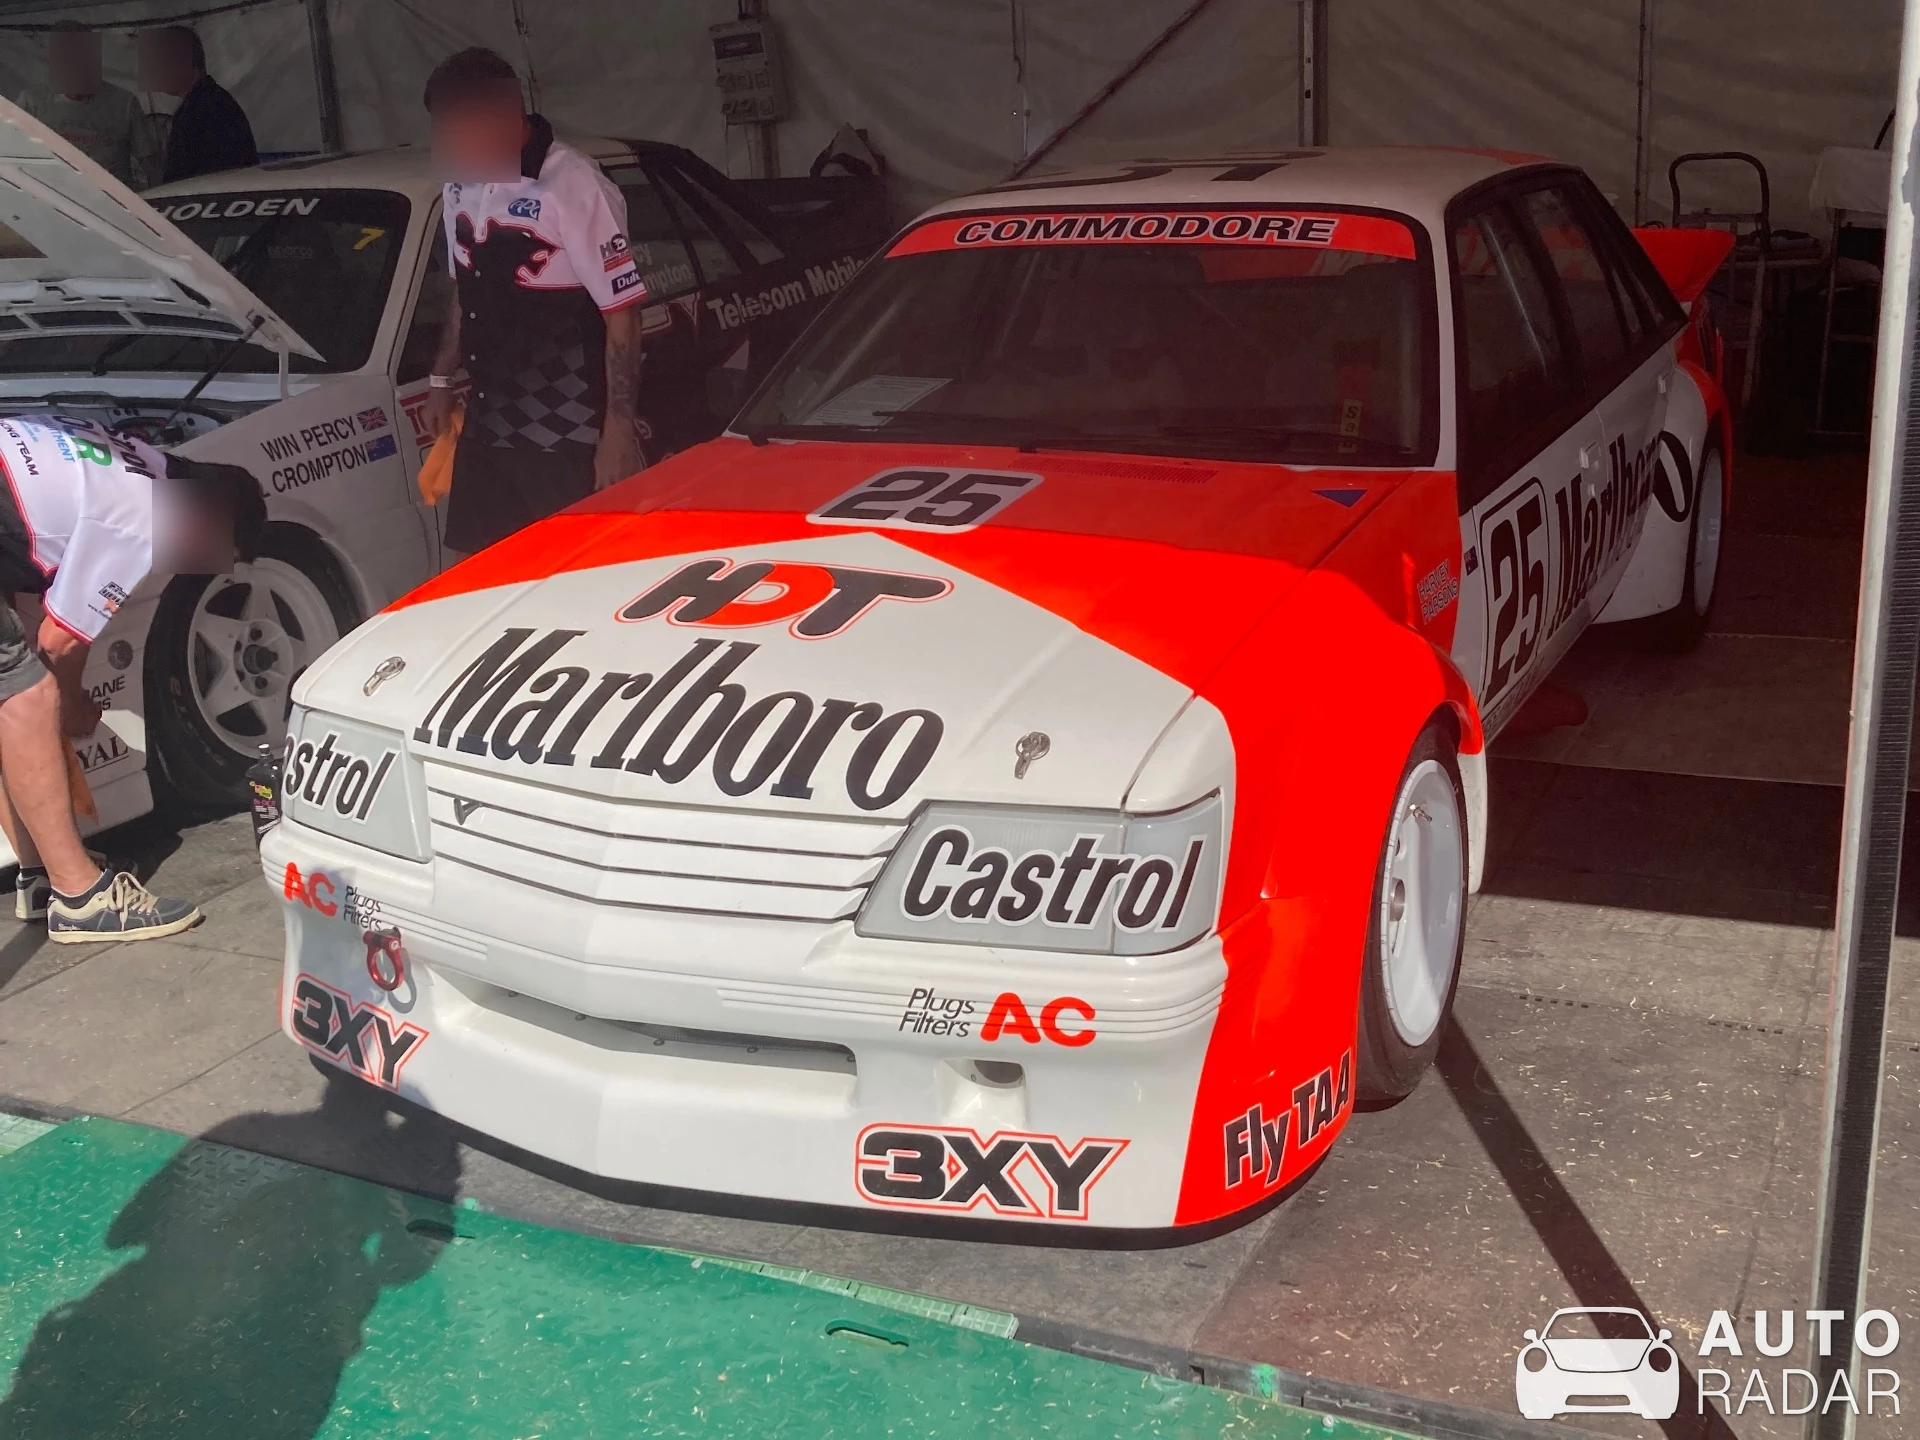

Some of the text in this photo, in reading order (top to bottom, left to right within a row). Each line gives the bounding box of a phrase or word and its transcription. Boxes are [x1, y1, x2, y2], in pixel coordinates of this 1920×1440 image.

[511, 197, 541, 219] PPG
[955, 213, 1339, 245] COMMODORE
[352, 226, 386, 250] 7
[706, 278, 806, 330] Telecom
[16, 440, 40, 477] TEAM
[261, 415, 358, 463] WIN PERCY
[272, 444, 368, 493] CROMPTON
[819, 471, 1034, 527] 25
[616, 557, 953, 639] HDT
[1483, 495, 1545, 709] 25
[413, 627, 945, 811] Marlboro
[283, 862, 338, 917] AC
[345, 885, 381, 915] Plugs
[902, 827, 1205, 930] Castrol
[343, 904, 381, 932] Filters
[898, 1010, 970, 1039] Filters
[907, 987, 977, 1023] Plugs
[979, 992, 1097, 1047] AC
[292, 975, 427, 1090] 3XY
[1224, 1048, 1351, 1189] Fly TAA
[857, 1124, 1127, 1217] 3XY
